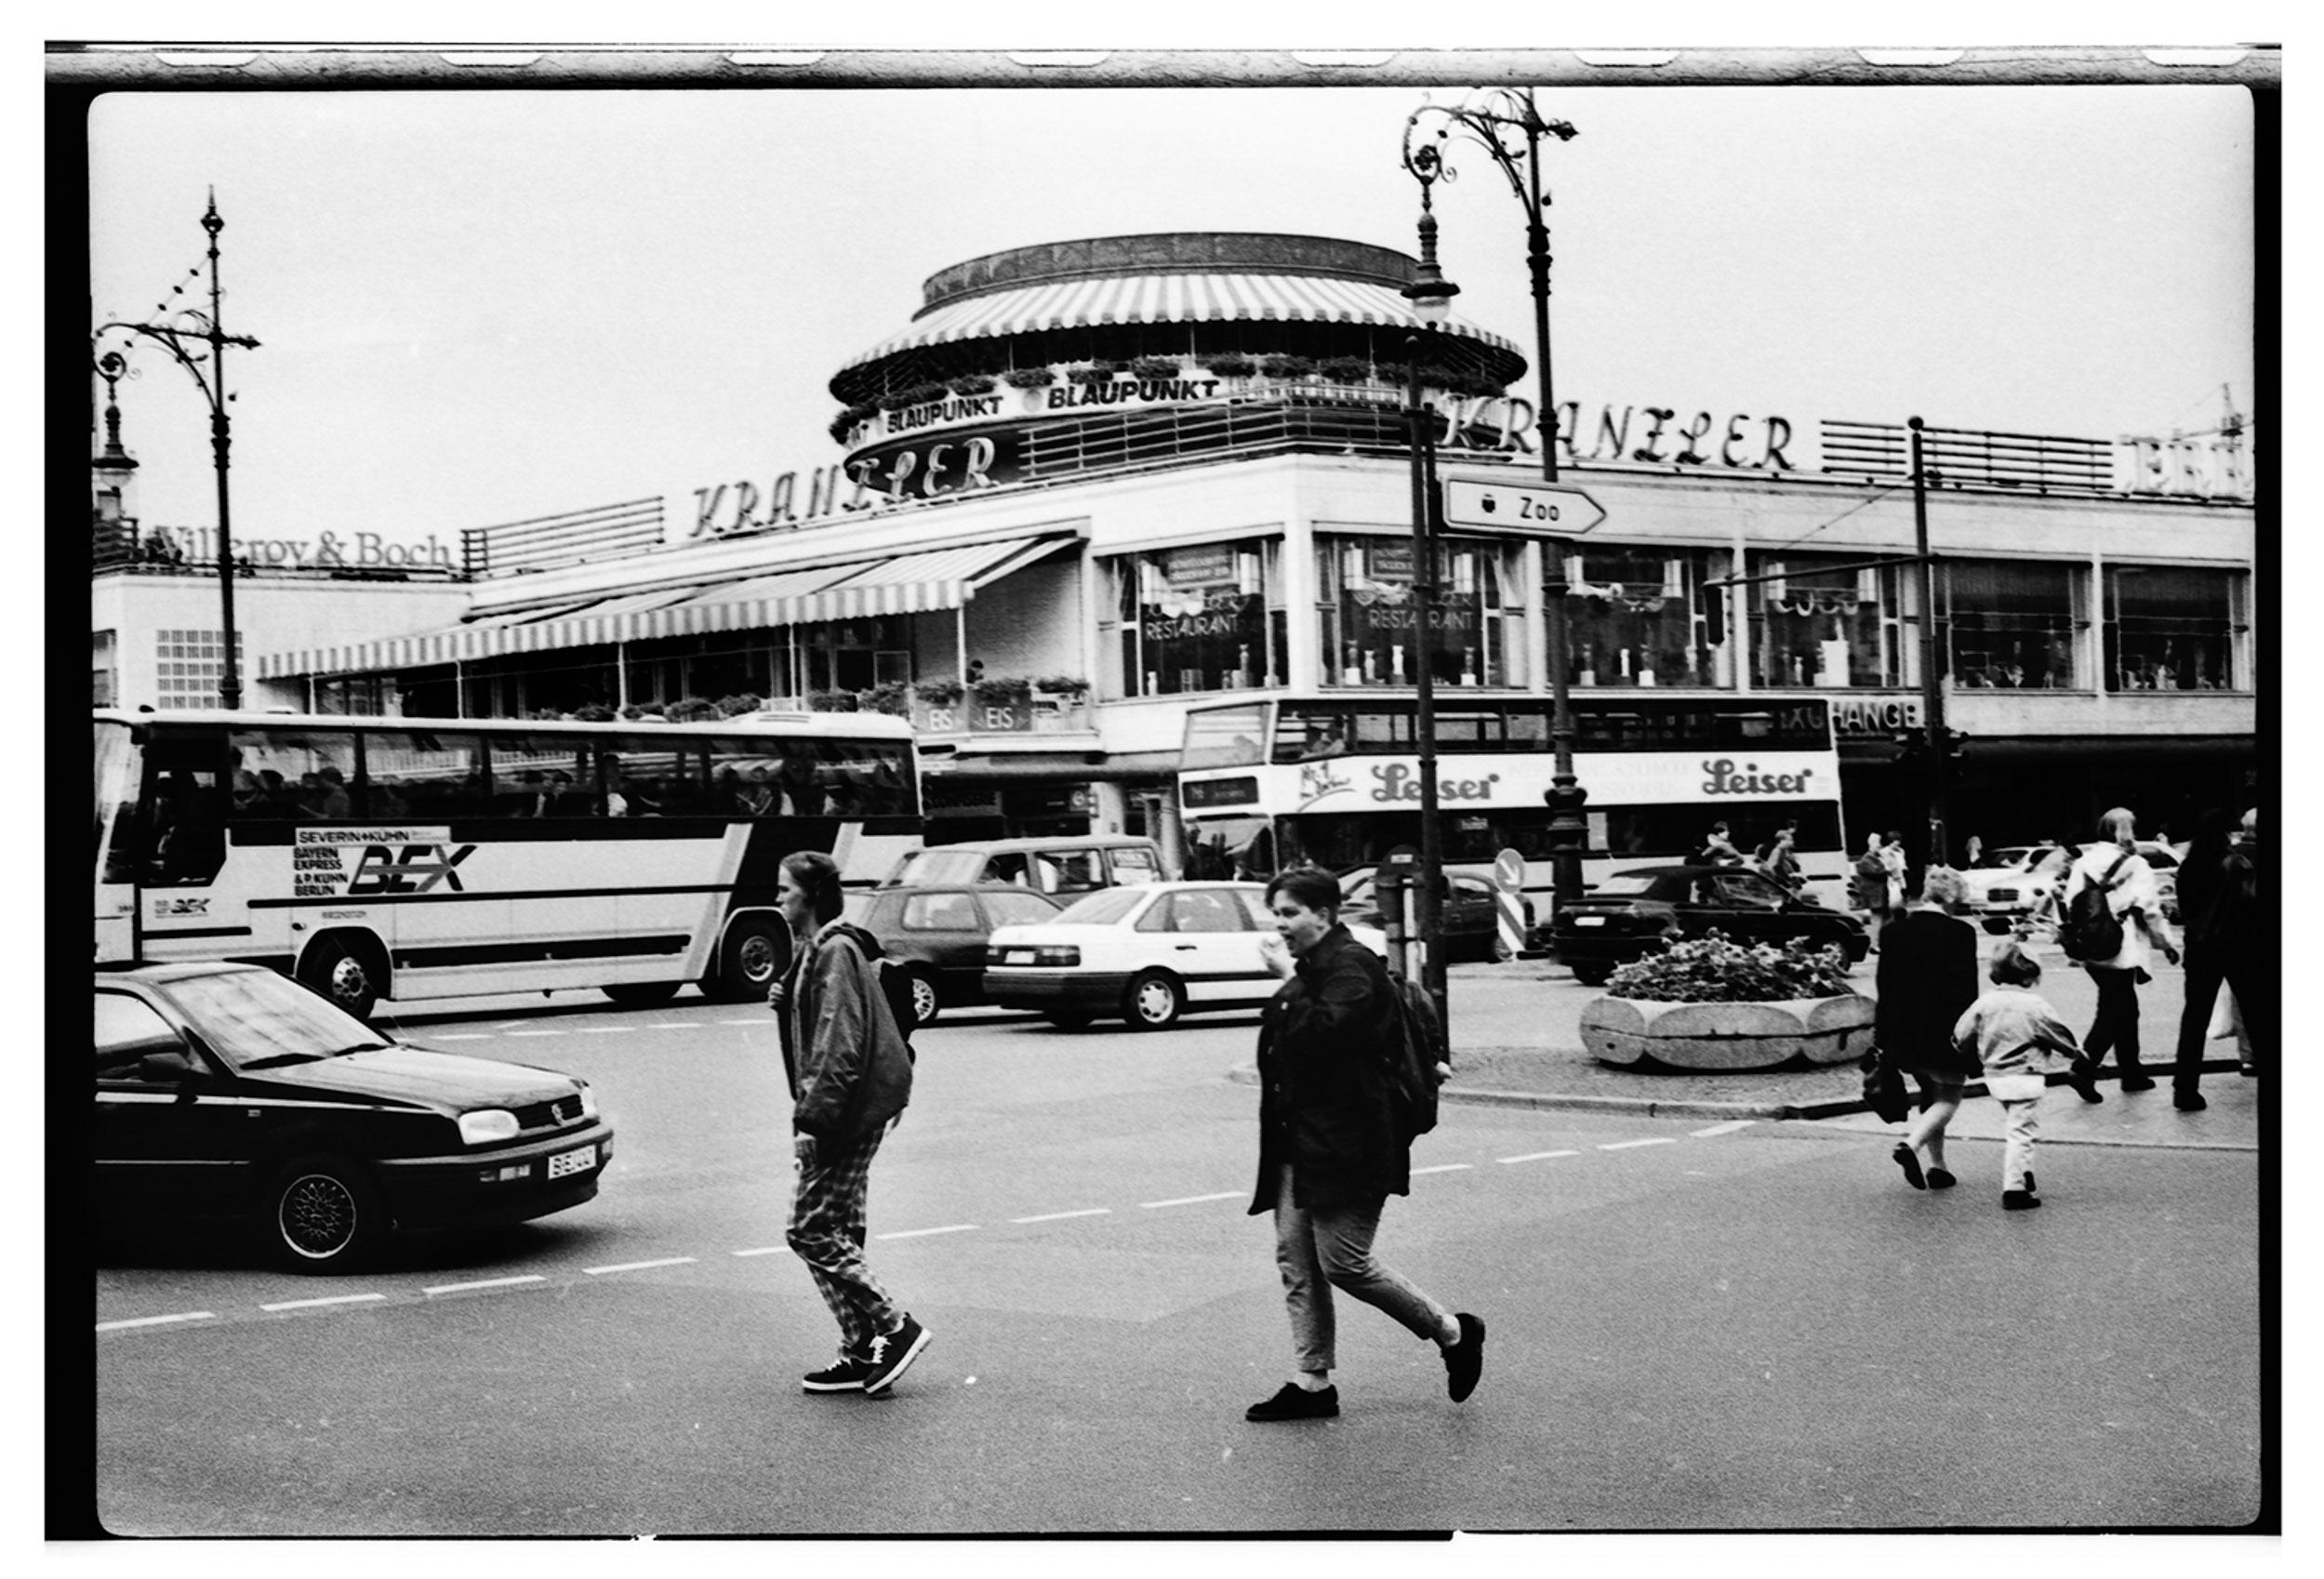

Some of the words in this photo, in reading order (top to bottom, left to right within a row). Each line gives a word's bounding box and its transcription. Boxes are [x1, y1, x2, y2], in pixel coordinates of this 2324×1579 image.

[1048, 379, 1219, 409] BLAUPUNKT
[887, 395, 1003, 433] BLAUPUNKT
[1435, 393, 1795, 470] KRANZLER
[689, 437, 1001, 537] KRANZLER
[1520, 497, 1560, 521] Zoo
[317, 530, 349, 566] &
[355, 532, 451, 567] Boch
[1146, 614, 1239, 640] RESTAURANT
[1369, 609, 1473, 630] RESTARANT
[986, 707, 1015, 729] EIS
[1372, 763, 1500, 802] Leser
[1702, 759, 1813, 795] Leiser
[294, 847, 339, 859] BAYERN
[294, 859, 343, 871] EXPRESS
[348, 844, 478, 895] BEX
[295, 885, 336, 897] BERLIN
